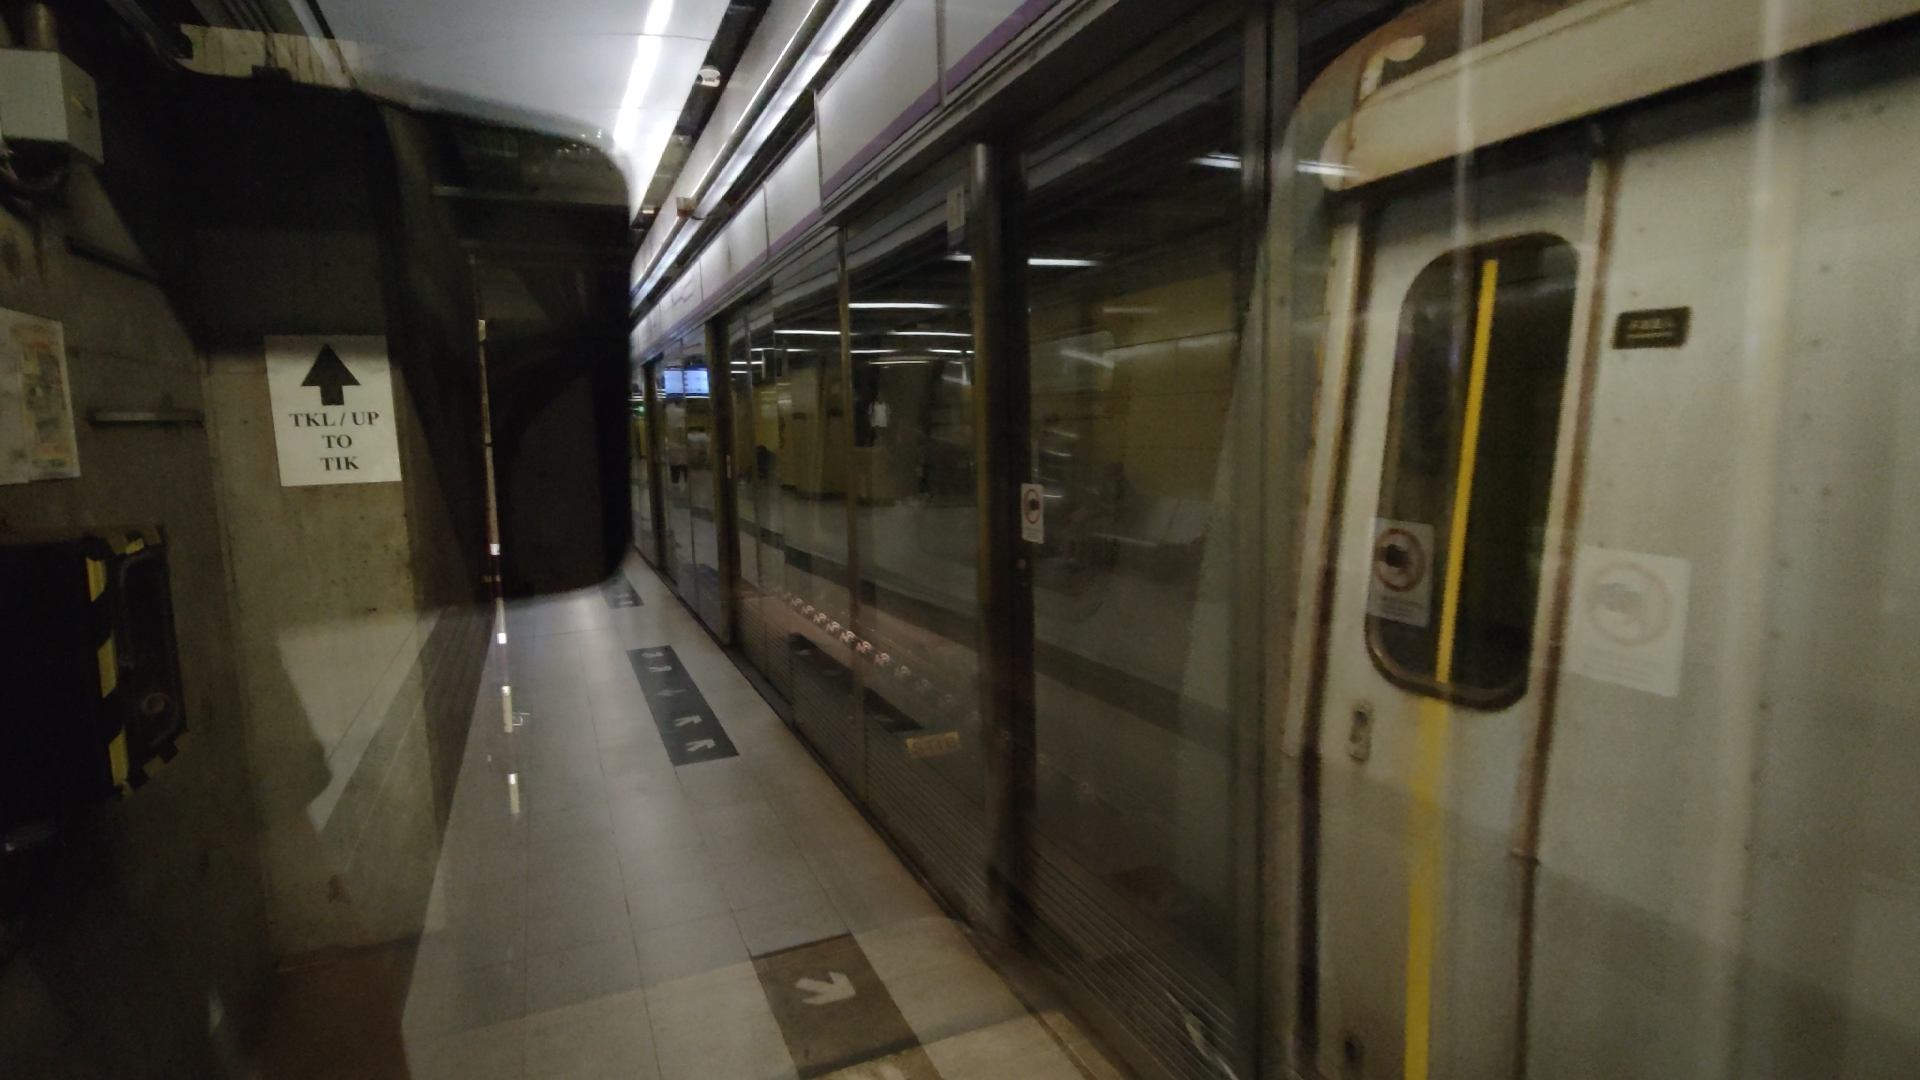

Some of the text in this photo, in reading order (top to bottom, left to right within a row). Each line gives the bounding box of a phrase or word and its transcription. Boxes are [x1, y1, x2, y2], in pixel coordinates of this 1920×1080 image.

[289, 412, 335, 427] TKL
[352, 411, 380, 426] UP
[323, 434, 352, 449] TO
[321, 457, 360, 471] TIK
